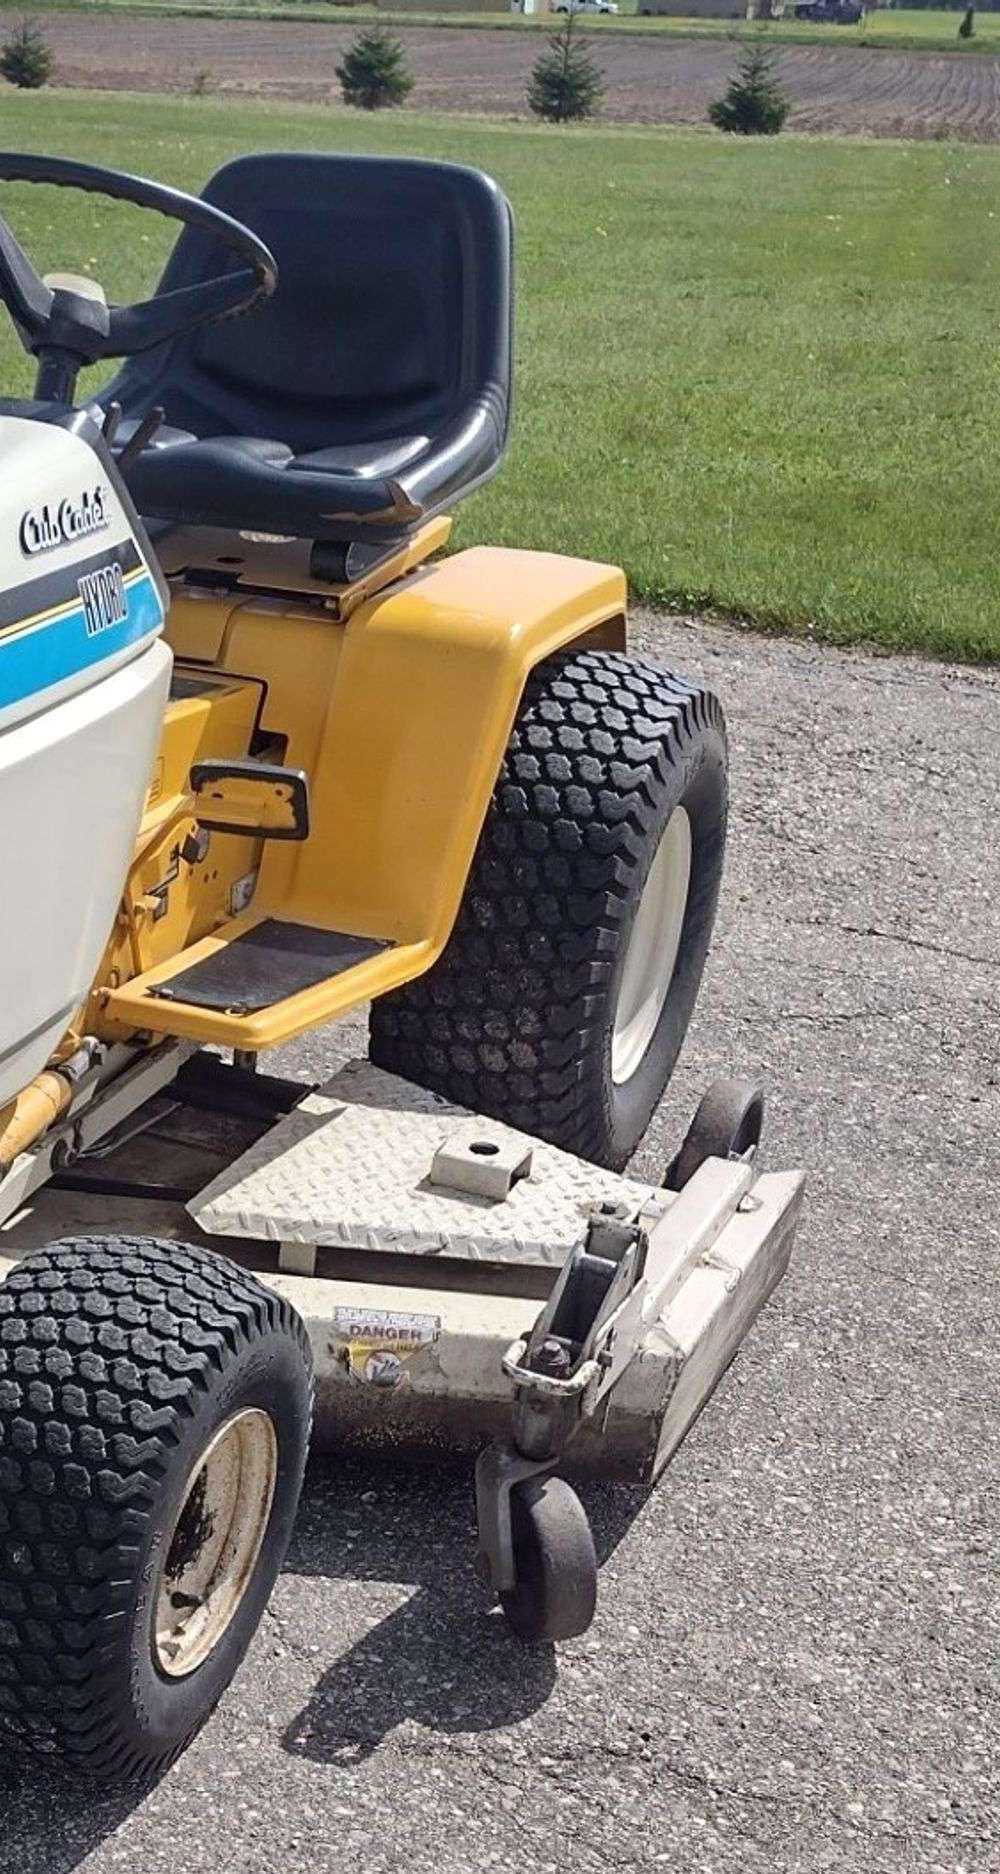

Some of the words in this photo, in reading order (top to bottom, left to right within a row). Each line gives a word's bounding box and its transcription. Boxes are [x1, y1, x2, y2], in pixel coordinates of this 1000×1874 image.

[20, 505, 61, 556] Cub
[58, 486, 108, 541] Cadet
[78, 563, 128, 637] HYDRO
[349, 1324, 422, 1341] DANGER
